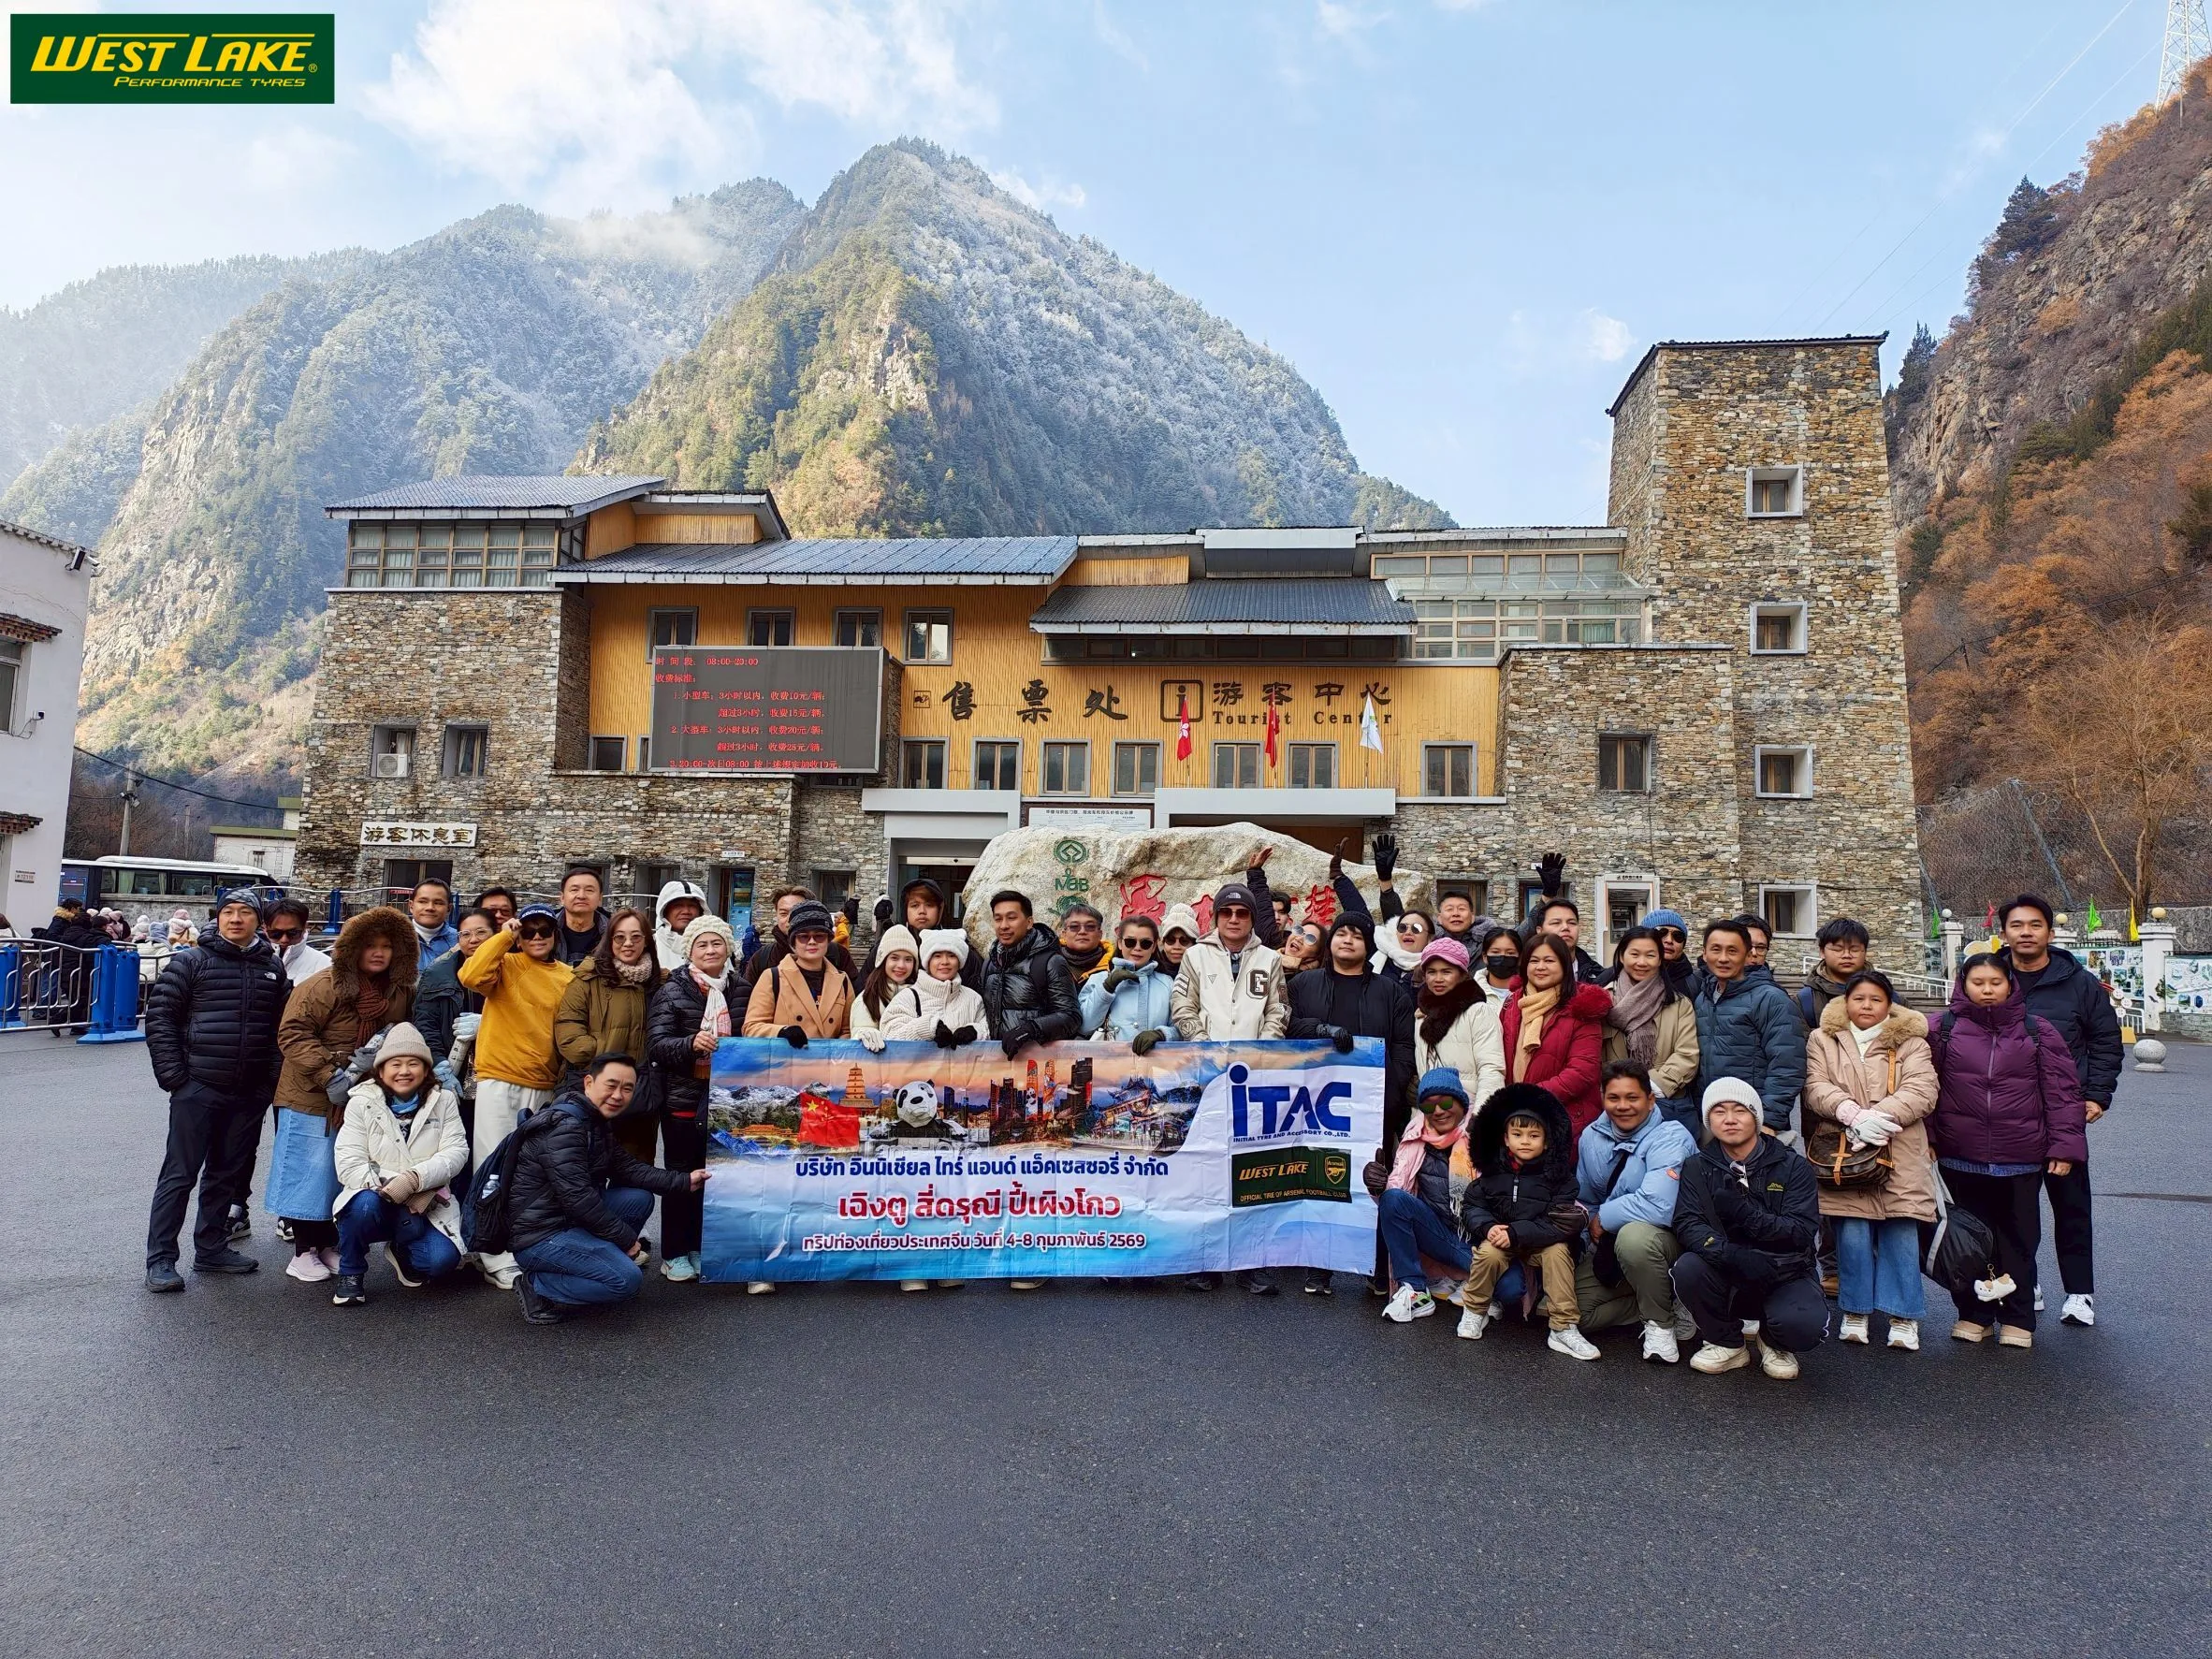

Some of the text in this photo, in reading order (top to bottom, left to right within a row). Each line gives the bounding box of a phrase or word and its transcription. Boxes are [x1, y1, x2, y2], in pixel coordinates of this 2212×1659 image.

[941, 678, 1128, 724] 售票处
[1213, 681, 1392, 706] 游客中心
[1213, 710, 1392, 725] Tourit Centr
[364, 825, 473, 844] 游客休息室
[1246, 968, 1269, 999] G
[795, 1156, 845, 1176] บริษัท
[935, 1156, 964, 1176] ไทร์
[968, 1156, 1017, 1175] แอนด์
[1021, 1152, 1120, 1175] แอ็คเซสซอรี่
[1124, 1155, 1169, 1176] จำกัด
[1239, 1163, 1309, 1181] WEST LAKE
[838, 1181, 1121, 1226] เฉิงตู สี่ดรุณี ปี้เผิงโกว
[1240, 1193, 1262, 1202] OFFICIAL
[1283, 1189, 1305, 1198] ARSENAL
[1306, 1188, 1332, 1197] FOOTBALL
[804, 1228, 1145, 1250] ทริปท่องเที่ยวประเทศจีน วันที่ 4-8 กุมภาพันธ์ 2569
